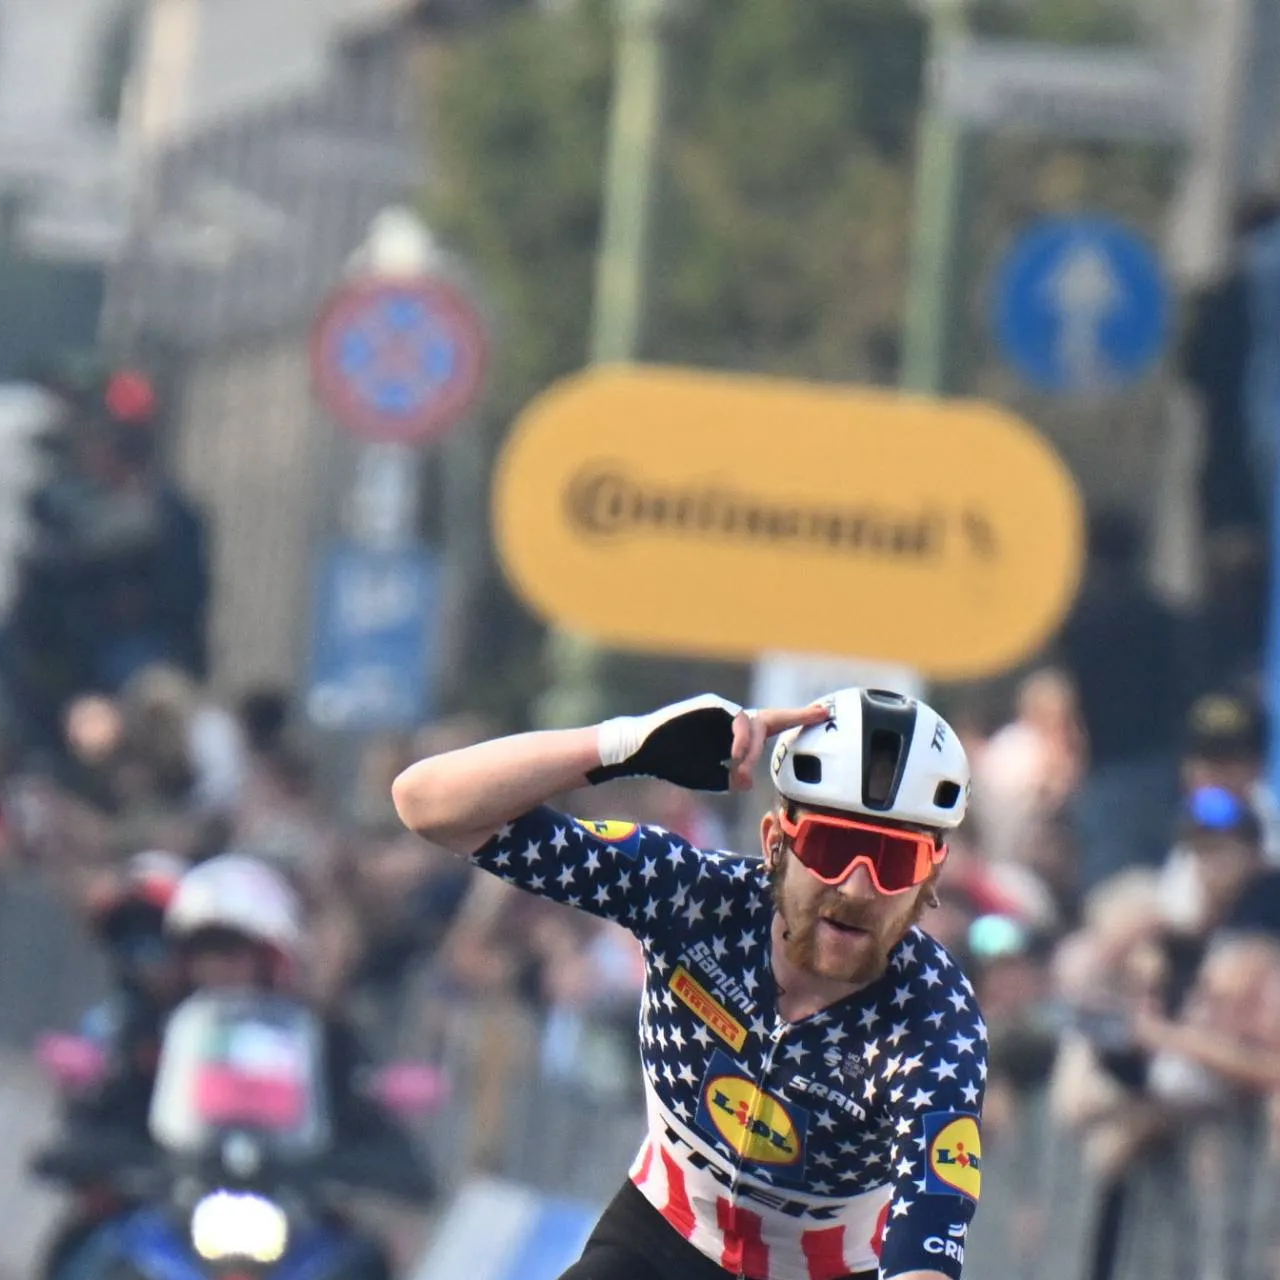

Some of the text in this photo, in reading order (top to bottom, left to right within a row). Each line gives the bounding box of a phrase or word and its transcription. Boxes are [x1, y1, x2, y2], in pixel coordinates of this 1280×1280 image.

[675, 975, 740, 1042] PIRELLI
[686, 941, 758, 1015] Santini
[788, 1074, 866, 1121] SRAM
[660, 1113, 847, 1221] TREK
